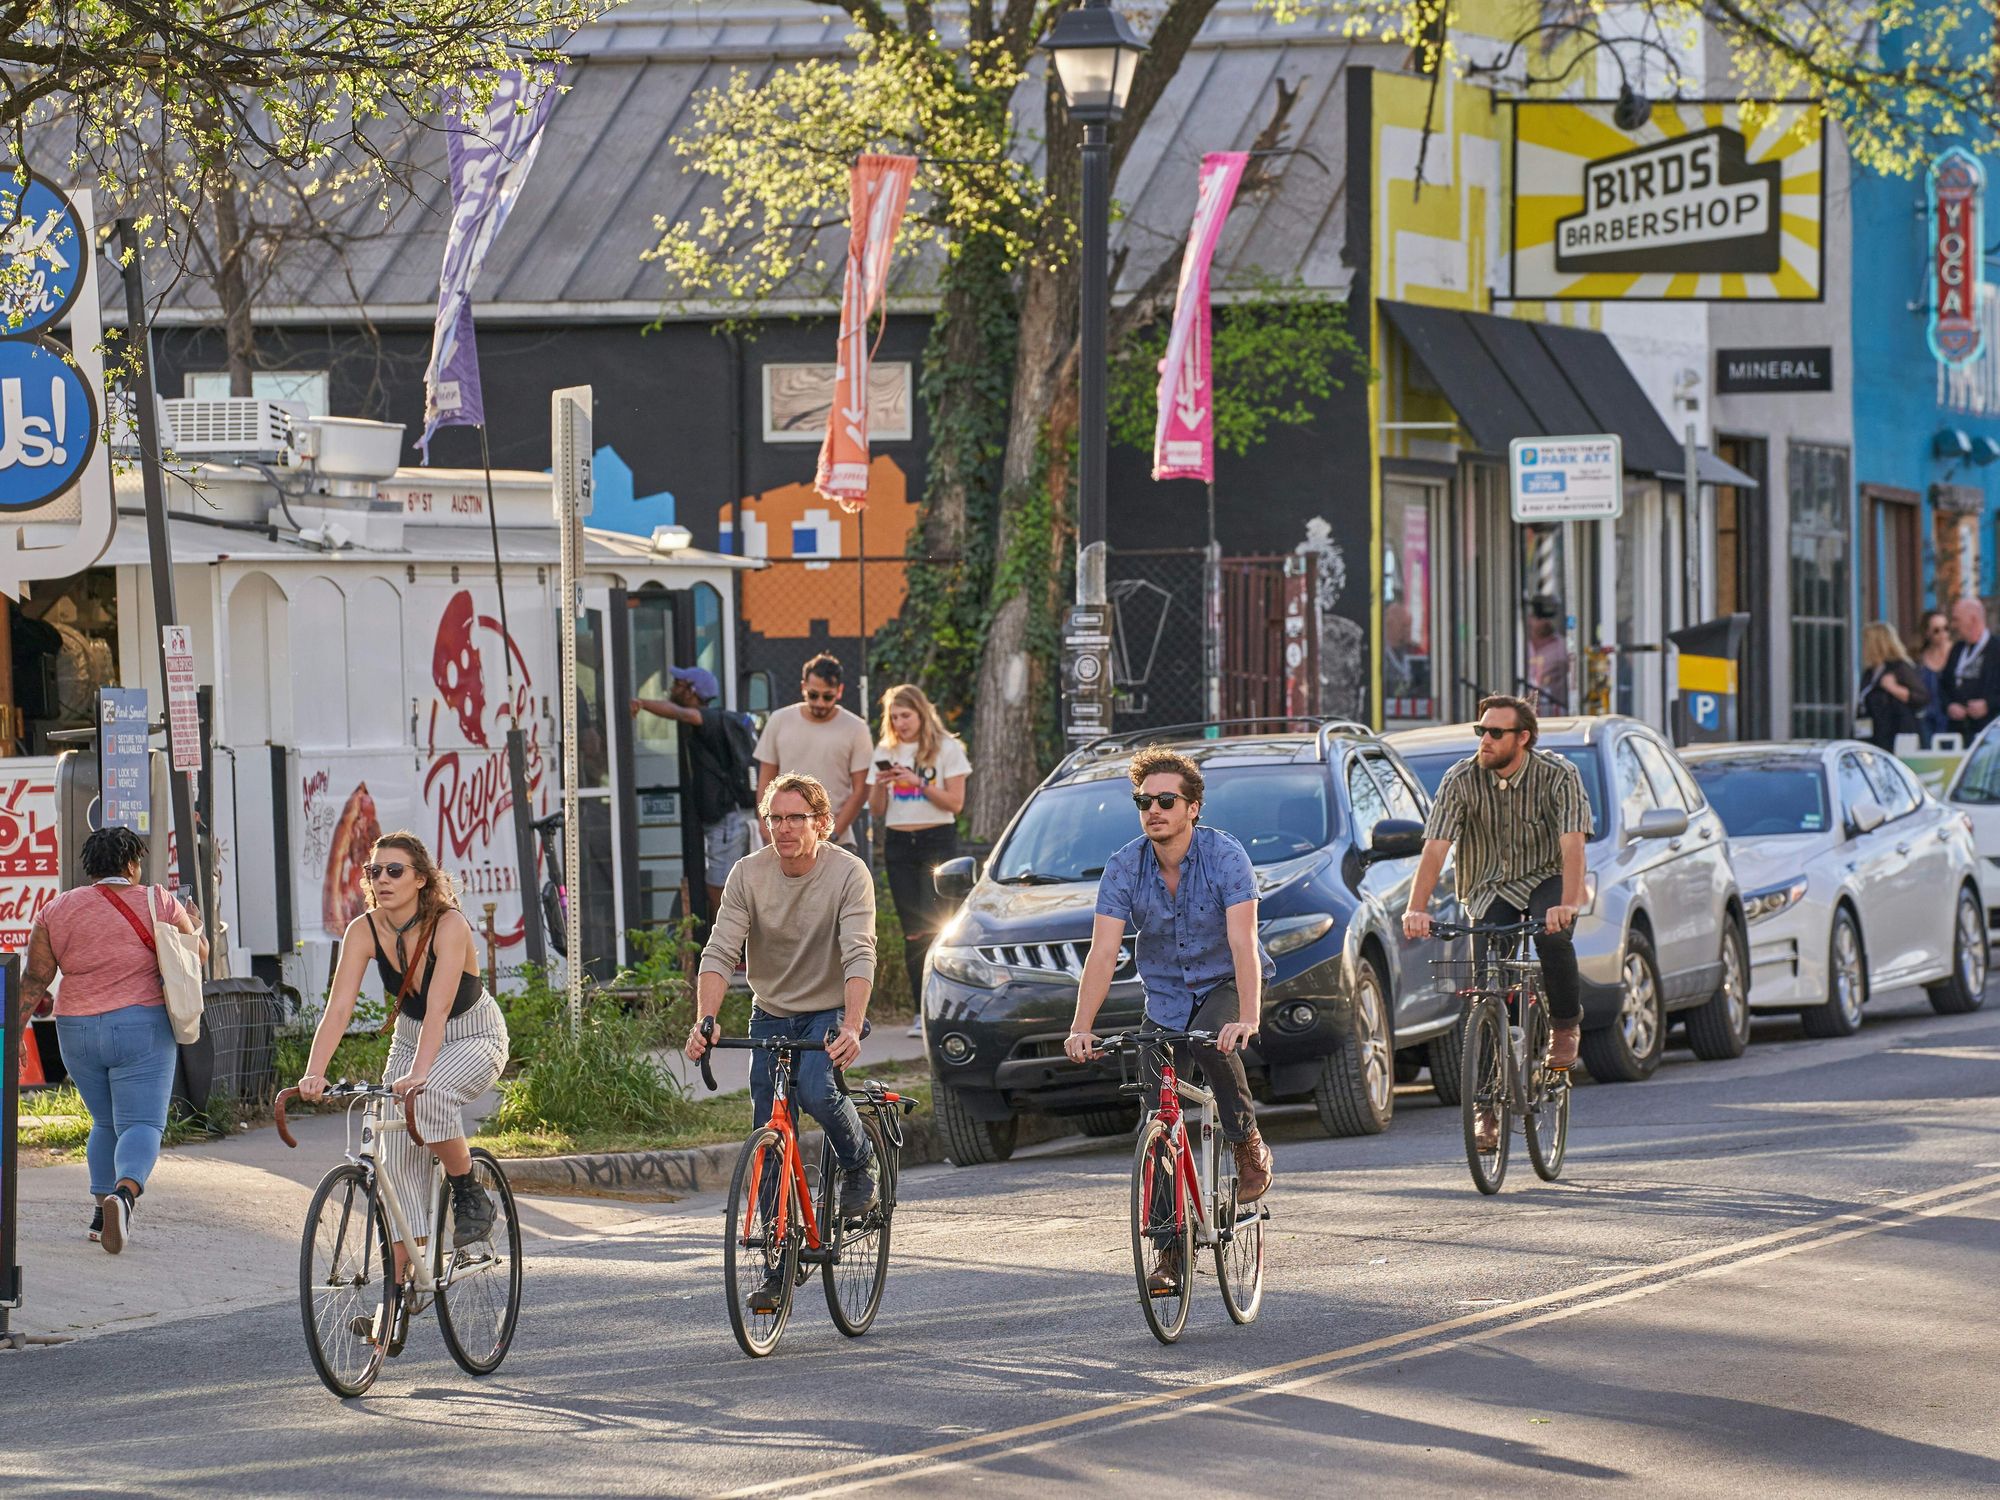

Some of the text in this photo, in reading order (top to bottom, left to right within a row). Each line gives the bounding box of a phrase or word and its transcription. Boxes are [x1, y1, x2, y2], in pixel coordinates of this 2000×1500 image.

[1592, 145, 1712, 210] BIRDS
[1565, 194, 1759, 247] BARBERSHOP
[1940, 203, 1966, 314] YOGA
[1728, 361, 1821, 380] MINERAL
[1541, 454, 1578, 464] PARK
[452, 494, 483, 513] AUSTIN
[1695, 694, 1715, 725] P
[118, 734, 147, 744] SECURE YOUR
[118, 744, 143, 754] VALUABLES
[118, 768, 139, 777] LOCK THE
[118, 778, 136, 788] VEHICLE
